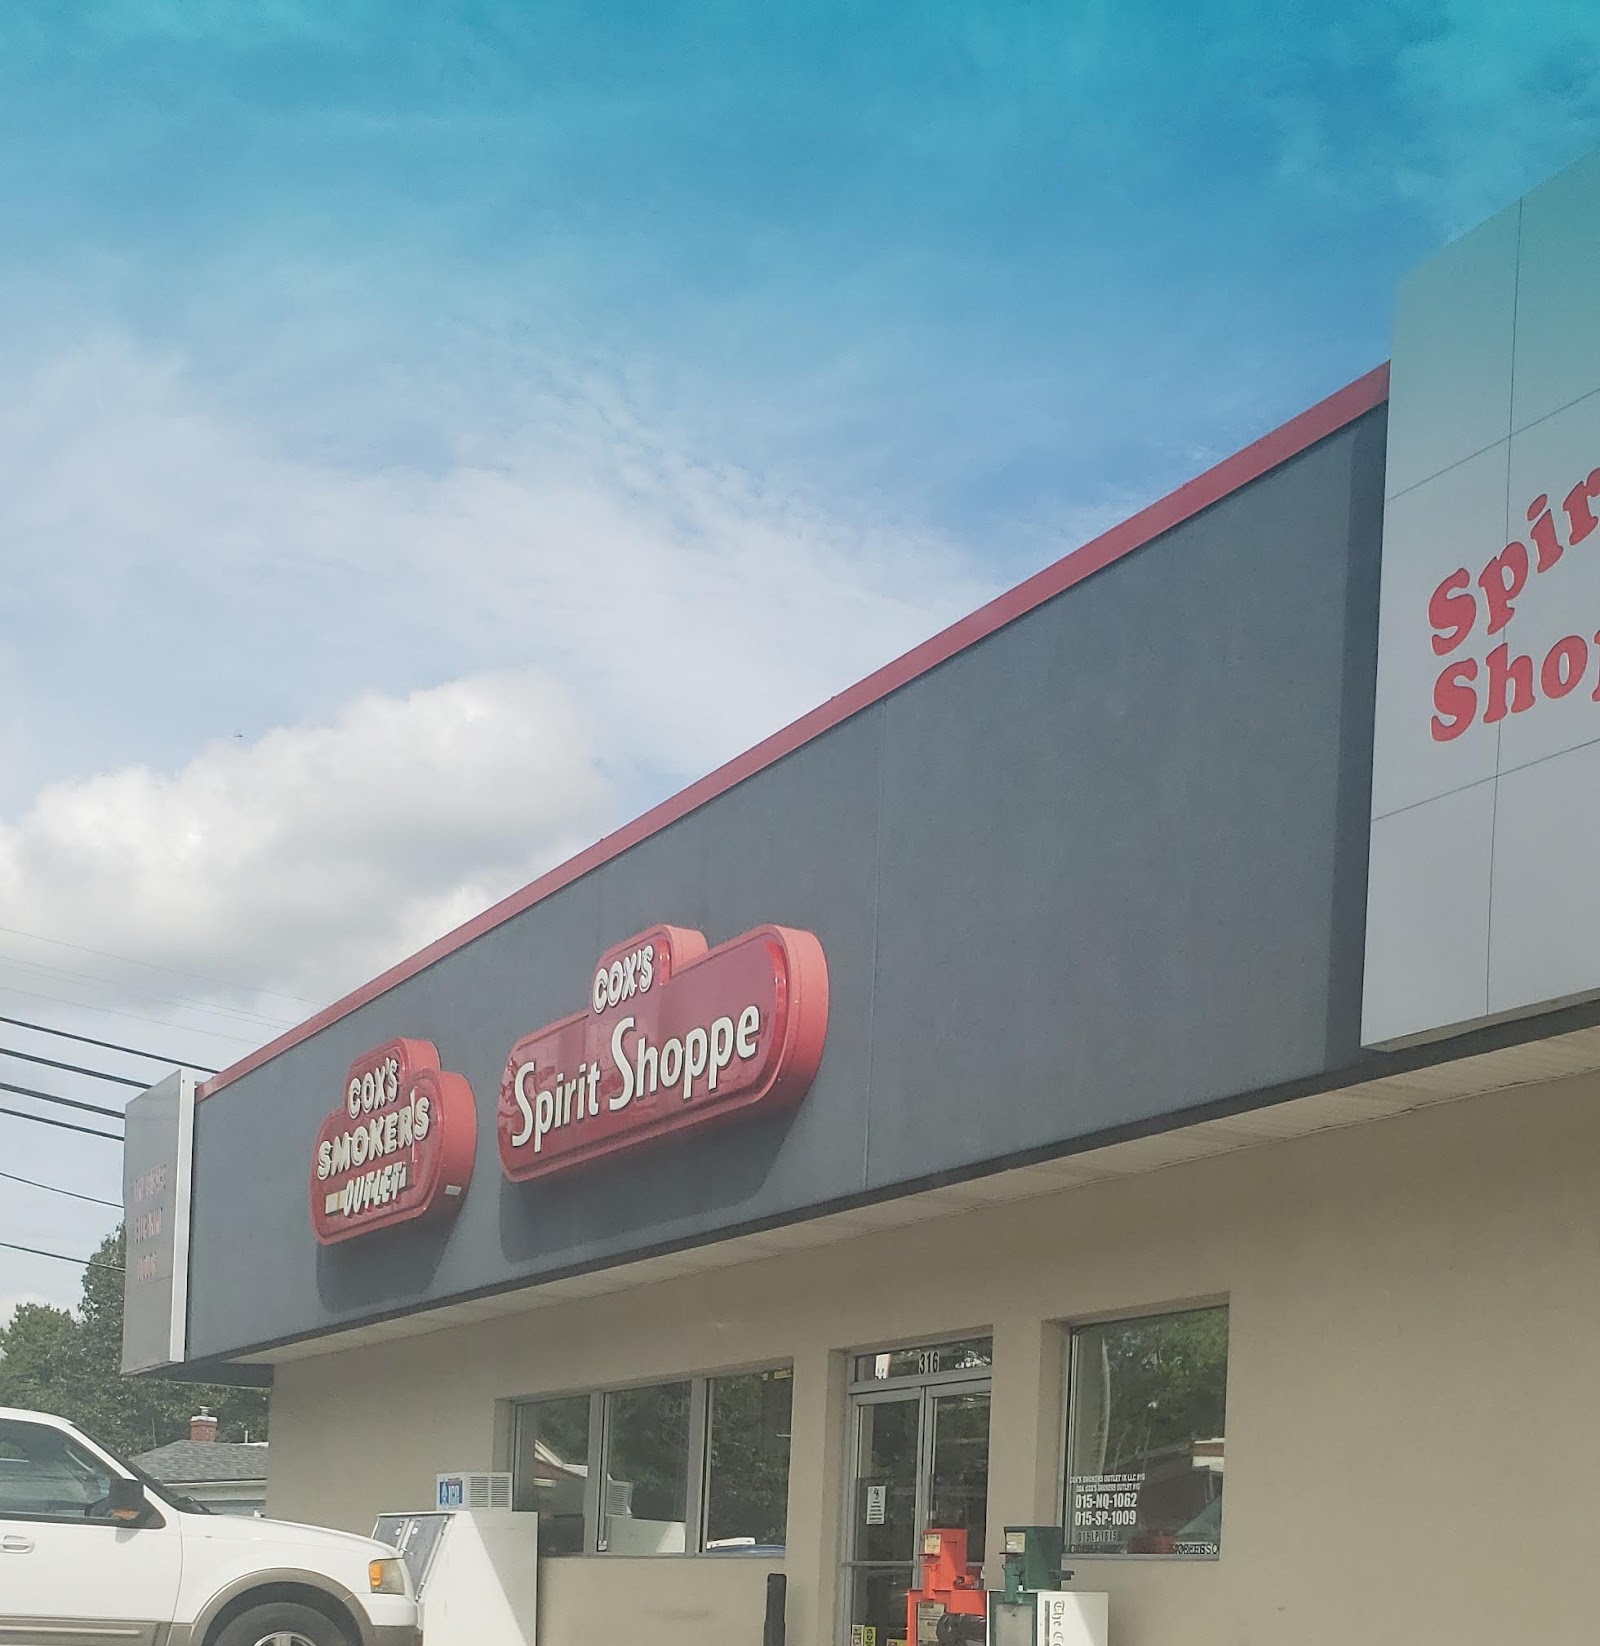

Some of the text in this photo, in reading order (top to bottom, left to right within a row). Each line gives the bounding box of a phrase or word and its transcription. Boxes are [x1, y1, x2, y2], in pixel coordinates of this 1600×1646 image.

[1431, 629, 1600, 742] Sho
[592, 944, 655, 1014] COX'S
[347, 1057, 398, 1119] COX'S
[511, 1005, 760, 1152] Spirit Shoppe
[343, 1161, 406, 1217] OUTLET
[919, 1351, 939, 1375] 316
[1075, 1492, 1138, 1509] 015-NQ-1062
[1075, 1510, 1137, 1526] 015-SP-1009
[1051, 1600, 1065, 1627] The
